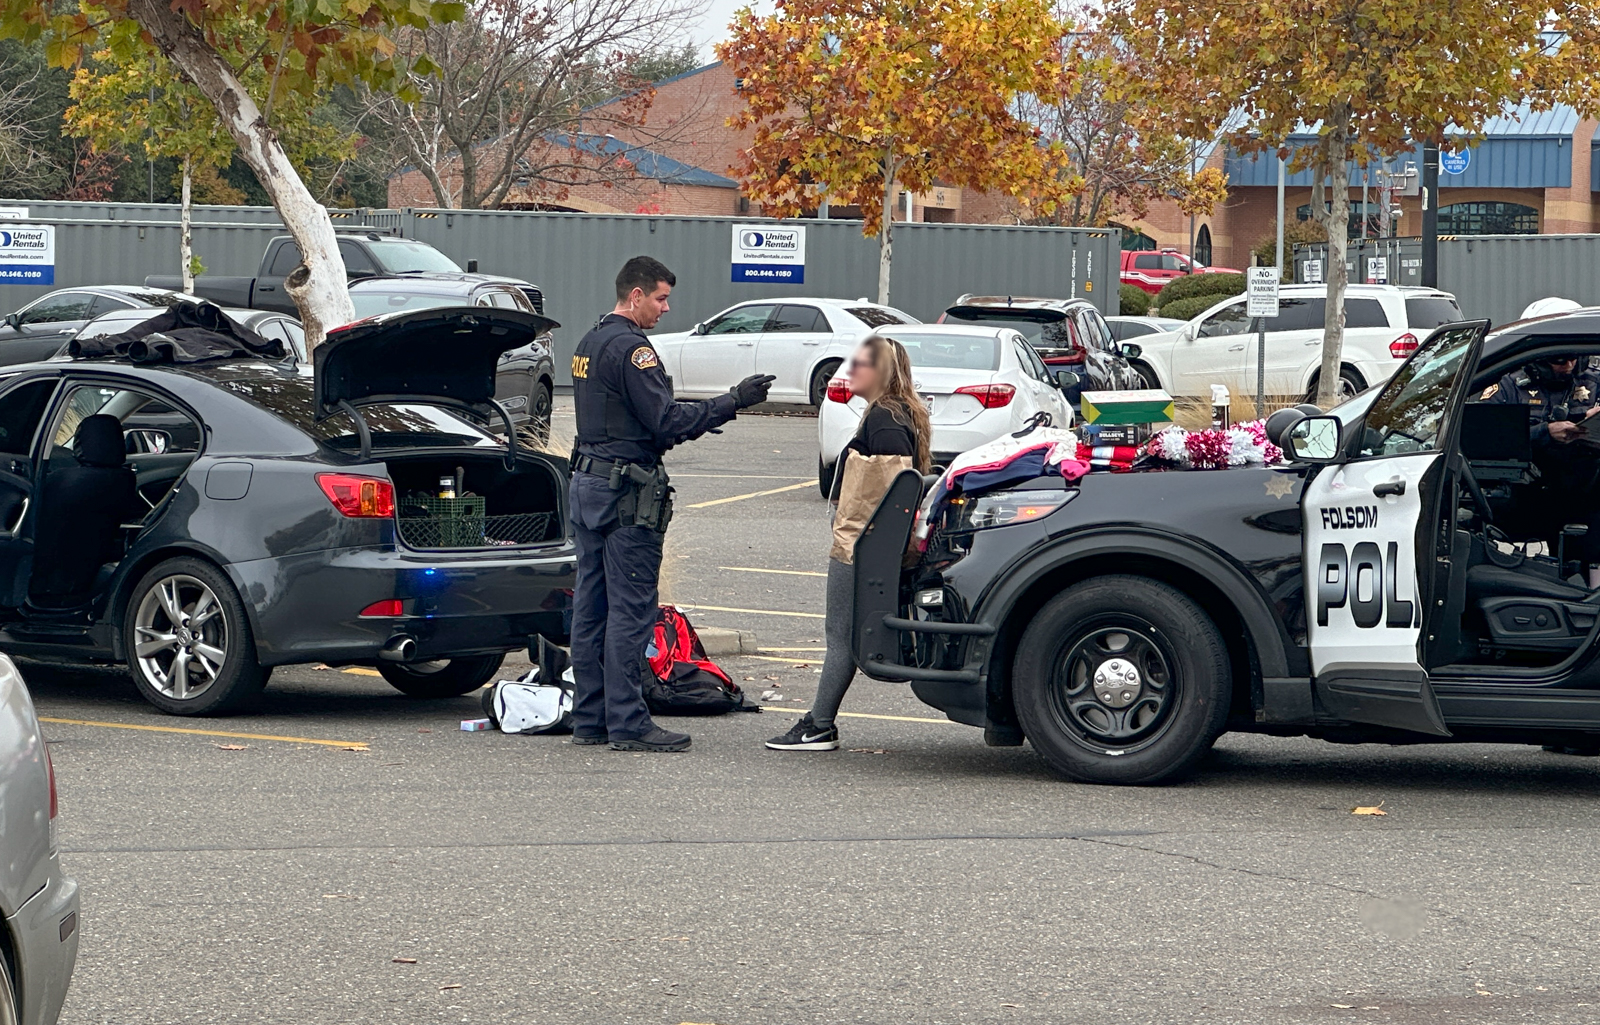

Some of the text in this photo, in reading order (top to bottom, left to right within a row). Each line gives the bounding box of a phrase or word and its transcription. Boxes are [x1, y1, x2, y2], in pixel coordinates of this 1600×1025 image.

[13, 232, 43, 240] United
[765, 233, 794, 241] United
[12, 240, 45, 248] Rentals
[764, 241, 795, 249] Rentals
[0, 270, 42, 278] 0.546.1050
[571, 355, 590, 379] POLICE
[1320, 505, 1378, 530] FOLSOM
[1317, 541, 1421, 629] POL
